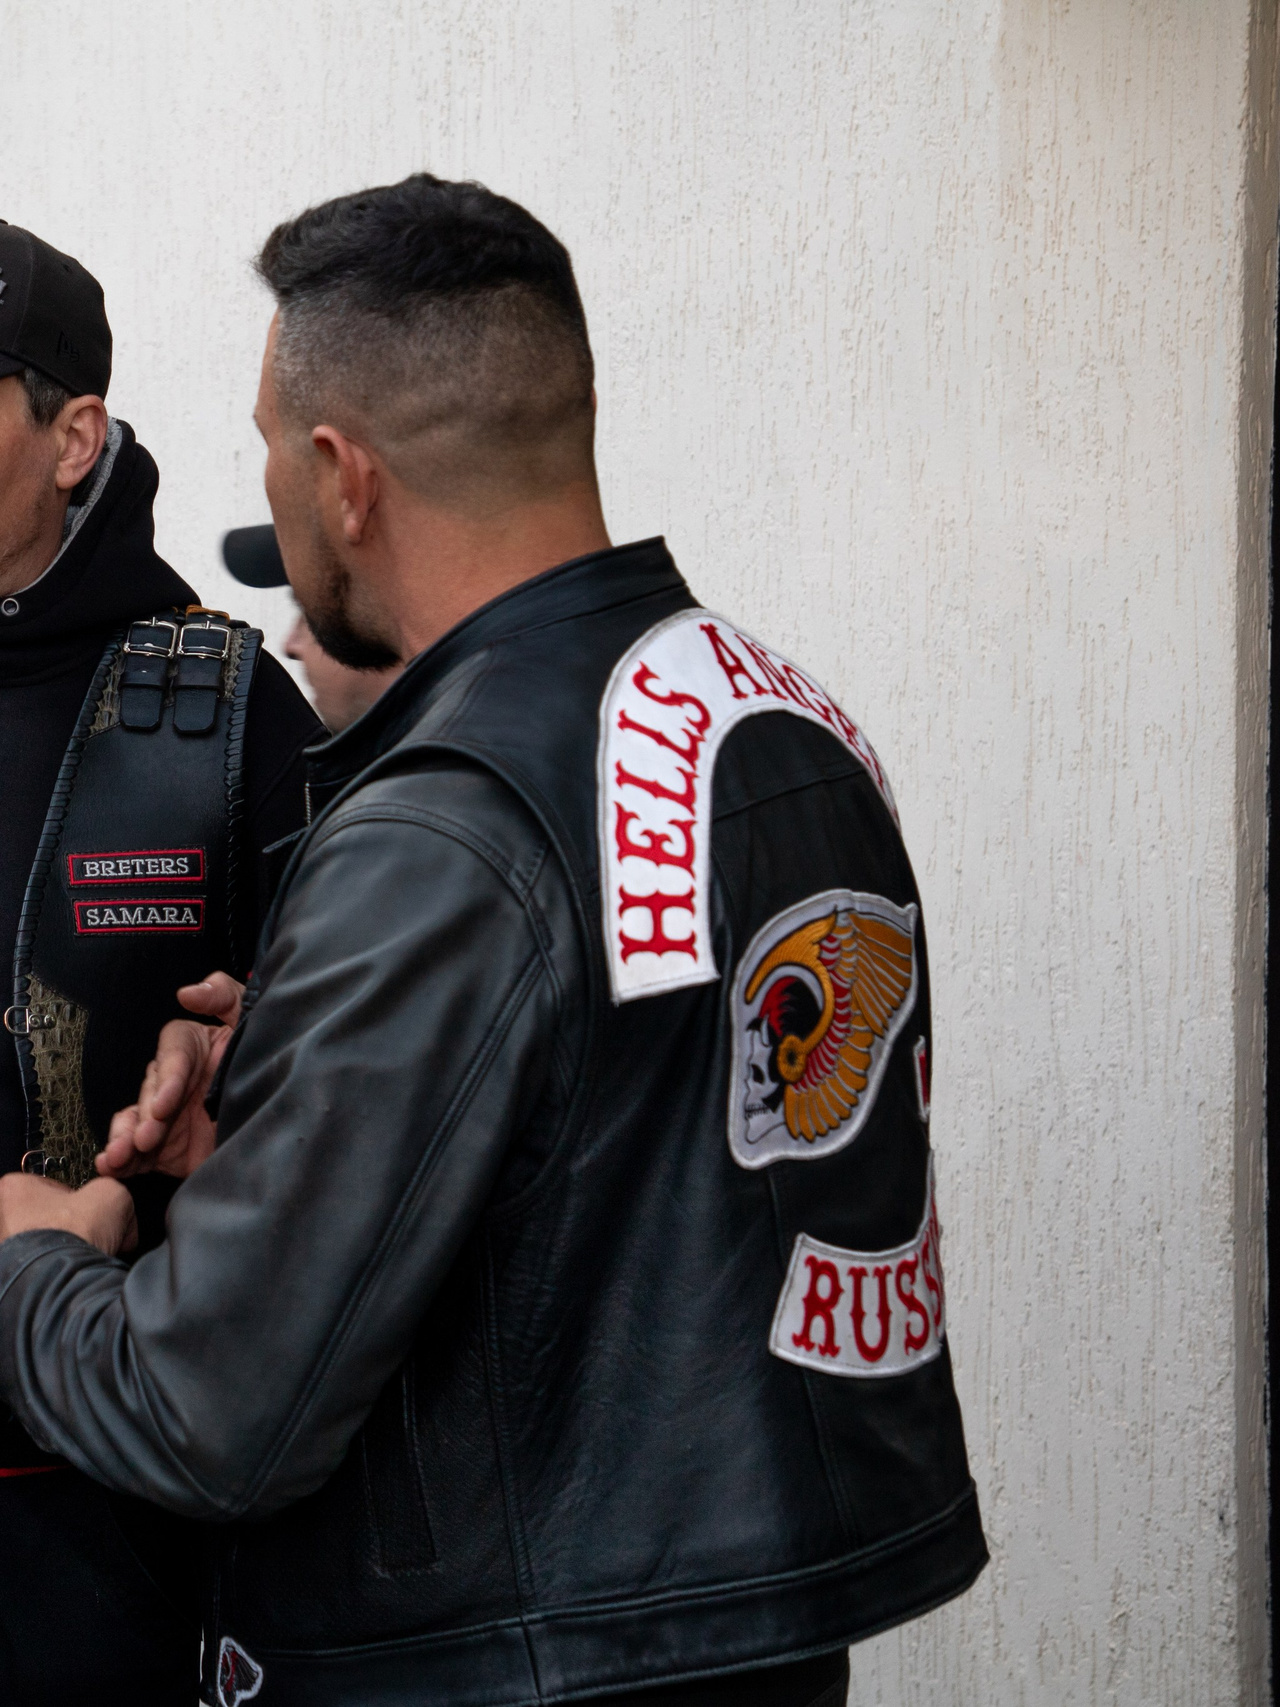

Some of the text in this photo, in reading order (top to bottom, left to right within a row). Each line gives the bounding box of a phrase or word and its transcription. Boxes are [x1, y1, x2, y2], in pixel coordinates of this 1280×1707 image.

[614, 623, 901, 965] HELLS ANGE
[83, 857, 190, 877] BRETERS
[86, 906, 198, 926] SAMARA
[792, 1180, 945, 1364] RUSS
